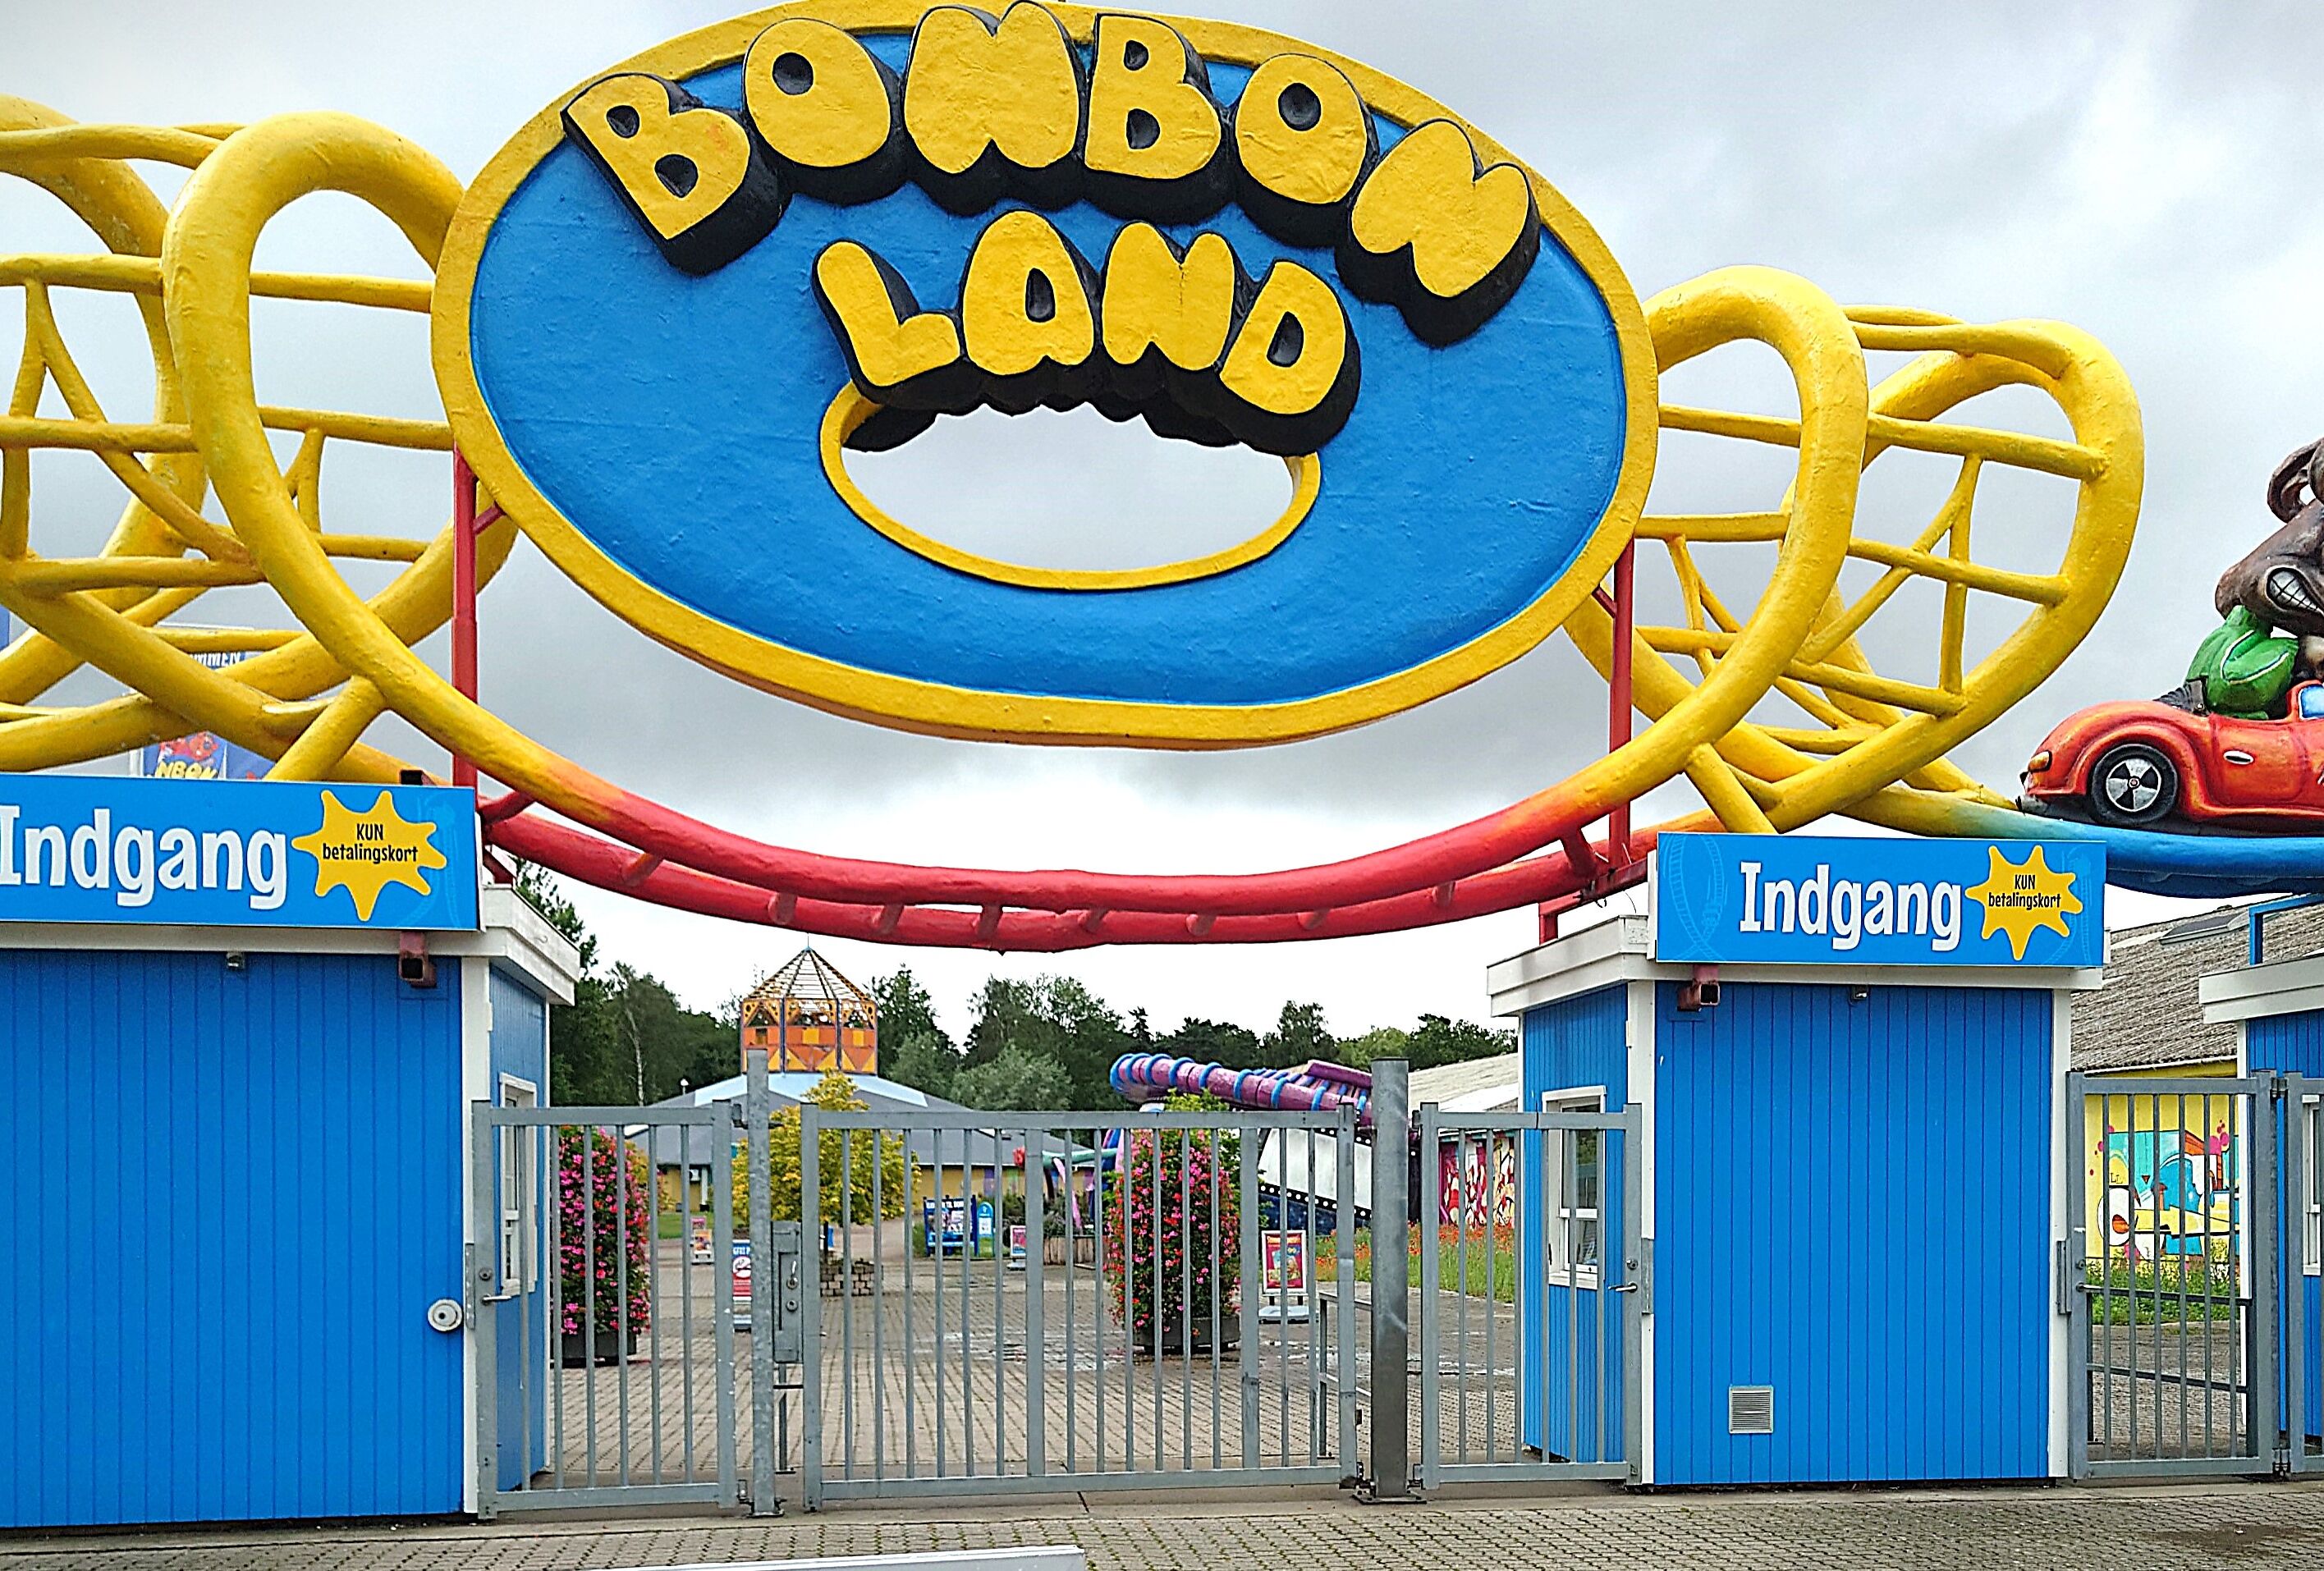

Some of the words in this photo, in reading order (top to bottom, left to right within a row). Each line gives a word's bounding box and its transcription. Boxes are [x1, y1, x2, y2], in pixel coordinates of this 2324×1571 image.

[816, 209, 1346, 415] LAND
[356, 823, 383, 840] KUN
[0, 804, 287, 910] Indgang
[323, 843, 418, 864] betalingskort
[2015, 874, 2036, 890] KUN
[1739, 861, 1962, 952] Indgang
[1988, 892, 2061, 910] betalingskort
